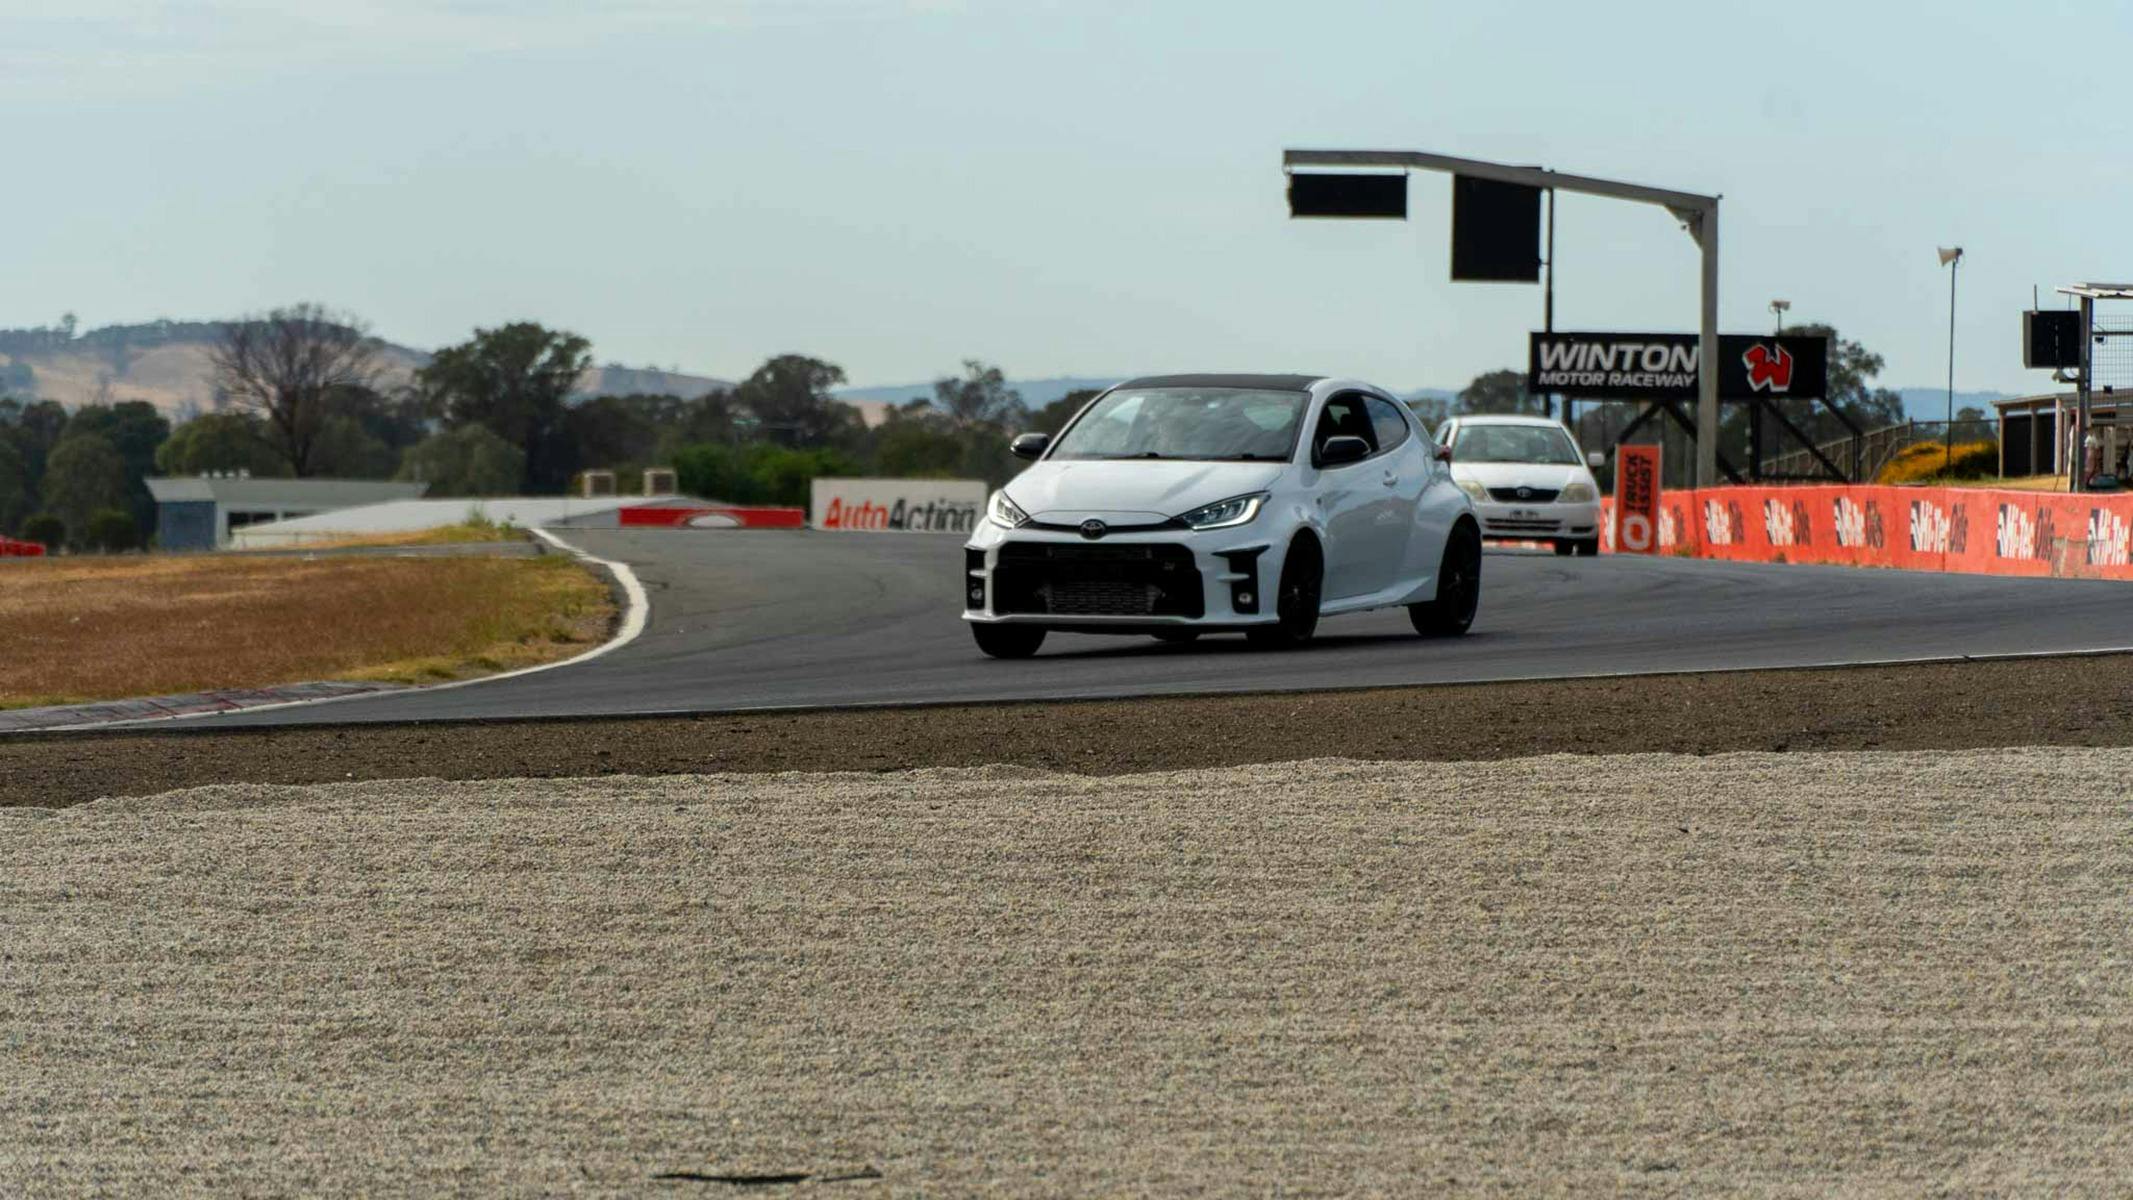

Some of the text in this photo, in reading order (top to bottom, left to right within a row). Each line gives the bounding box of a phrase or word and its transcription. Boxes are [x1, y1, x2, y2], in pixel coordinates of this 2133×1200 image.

[1538, 341, 1699, 373] WINTON
[1537, 371, 1697, 388] MOTOR RACEWAY
